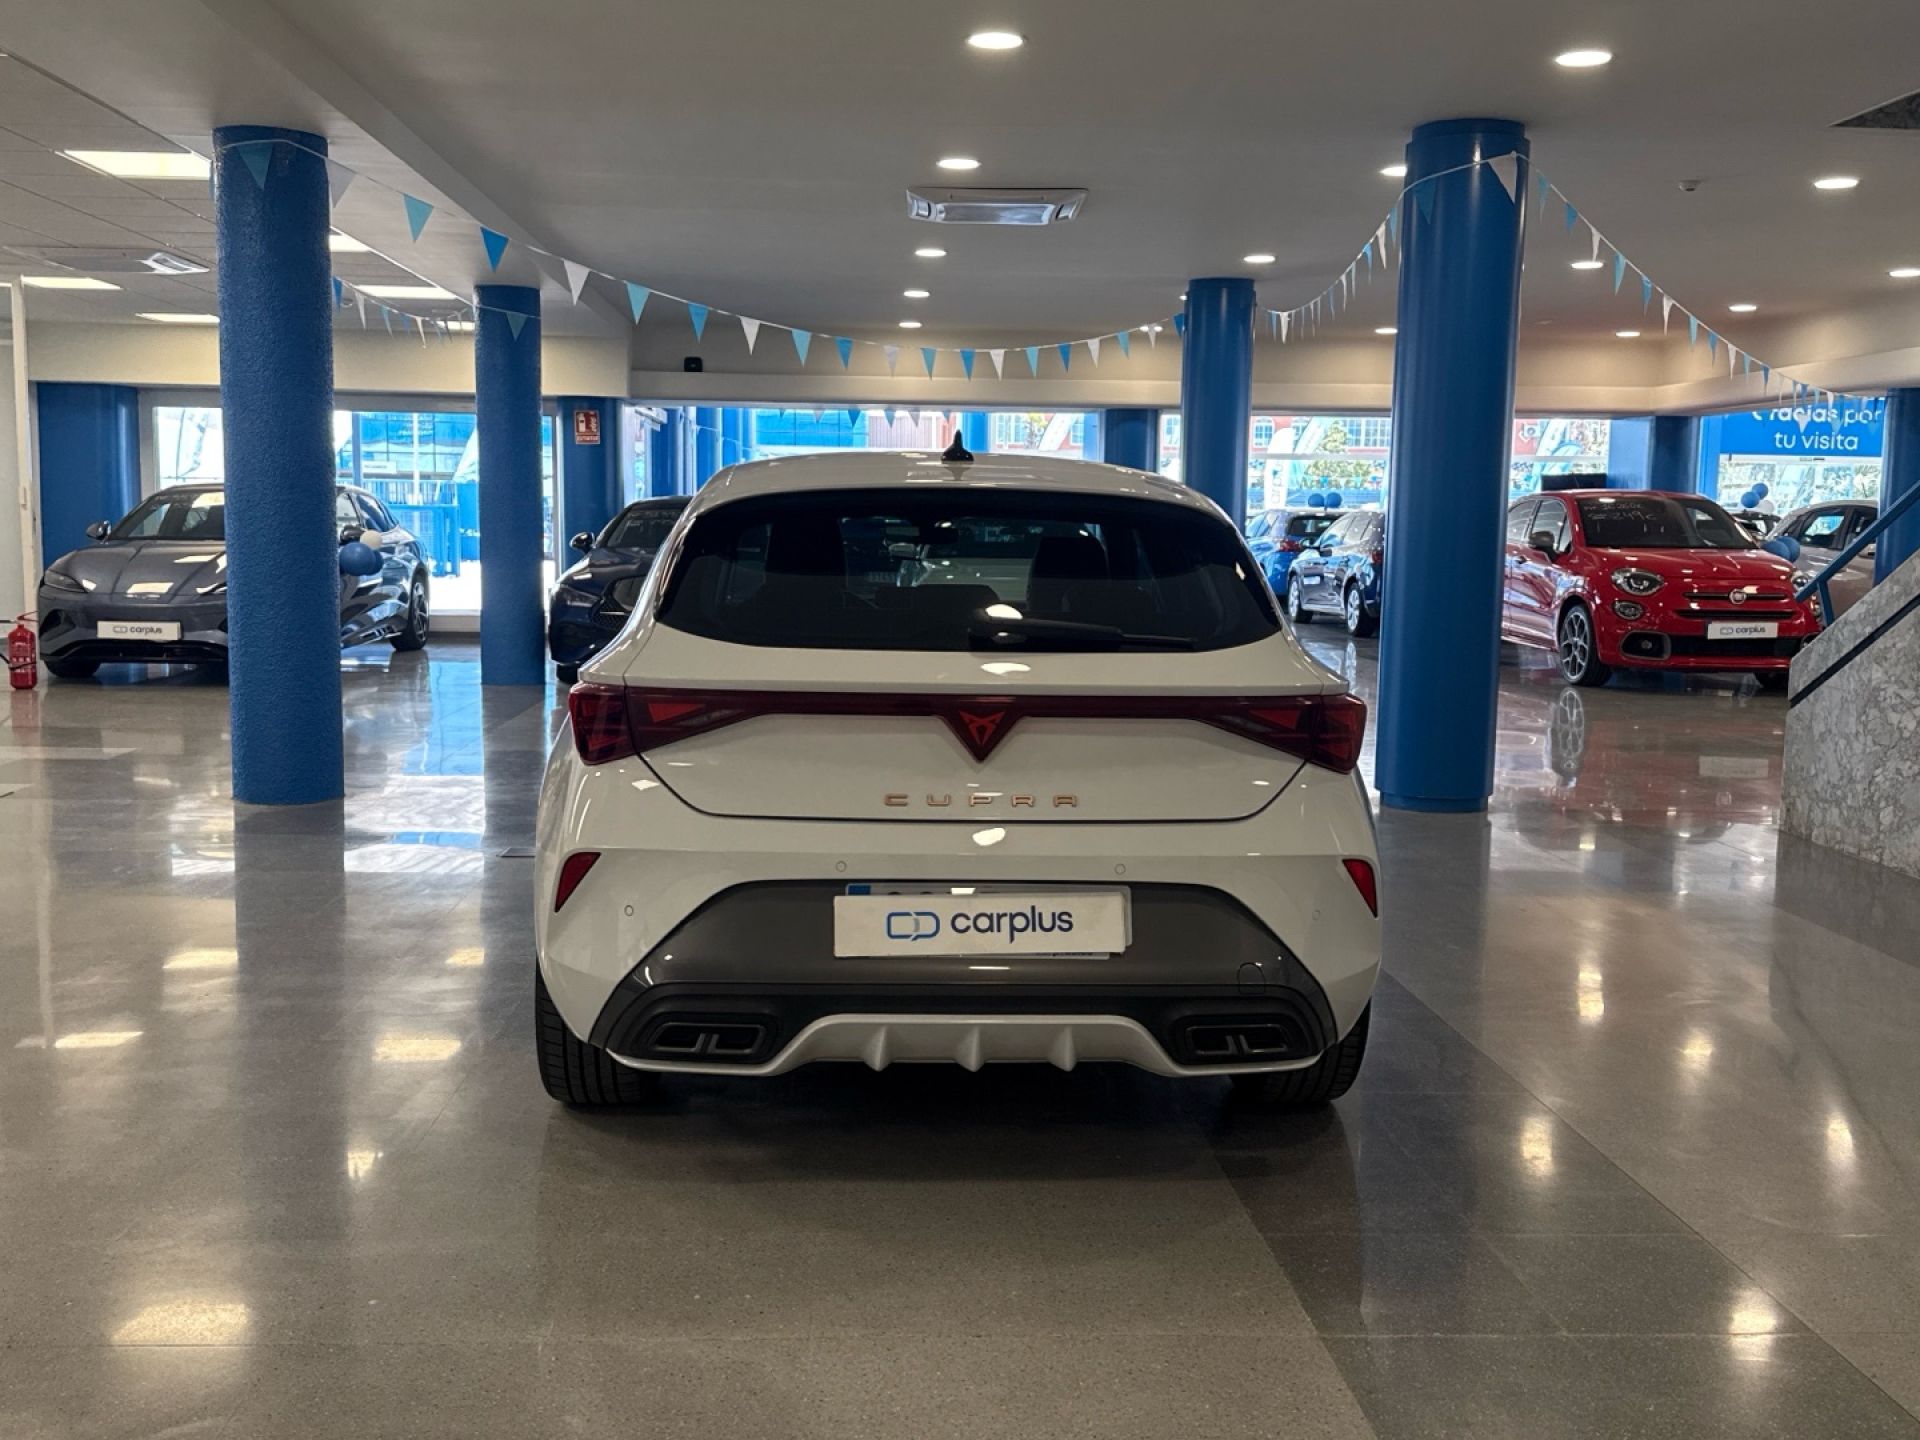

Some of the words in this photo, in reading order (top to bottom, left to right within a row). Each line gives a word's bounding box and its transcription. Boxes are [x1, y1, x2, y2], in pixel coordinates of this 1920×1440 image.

[1845, 409, 1882, 427] por
[1775, 432, 1796, 448] tu
[1802, 431, 1859, 450] visita
[130, 626, 163, 635] carplus
[1735, 625, 1766, 635] carplus
[884, 792, 1080, 808] CUPRA
[950, 904, 1074, 944] carplus
